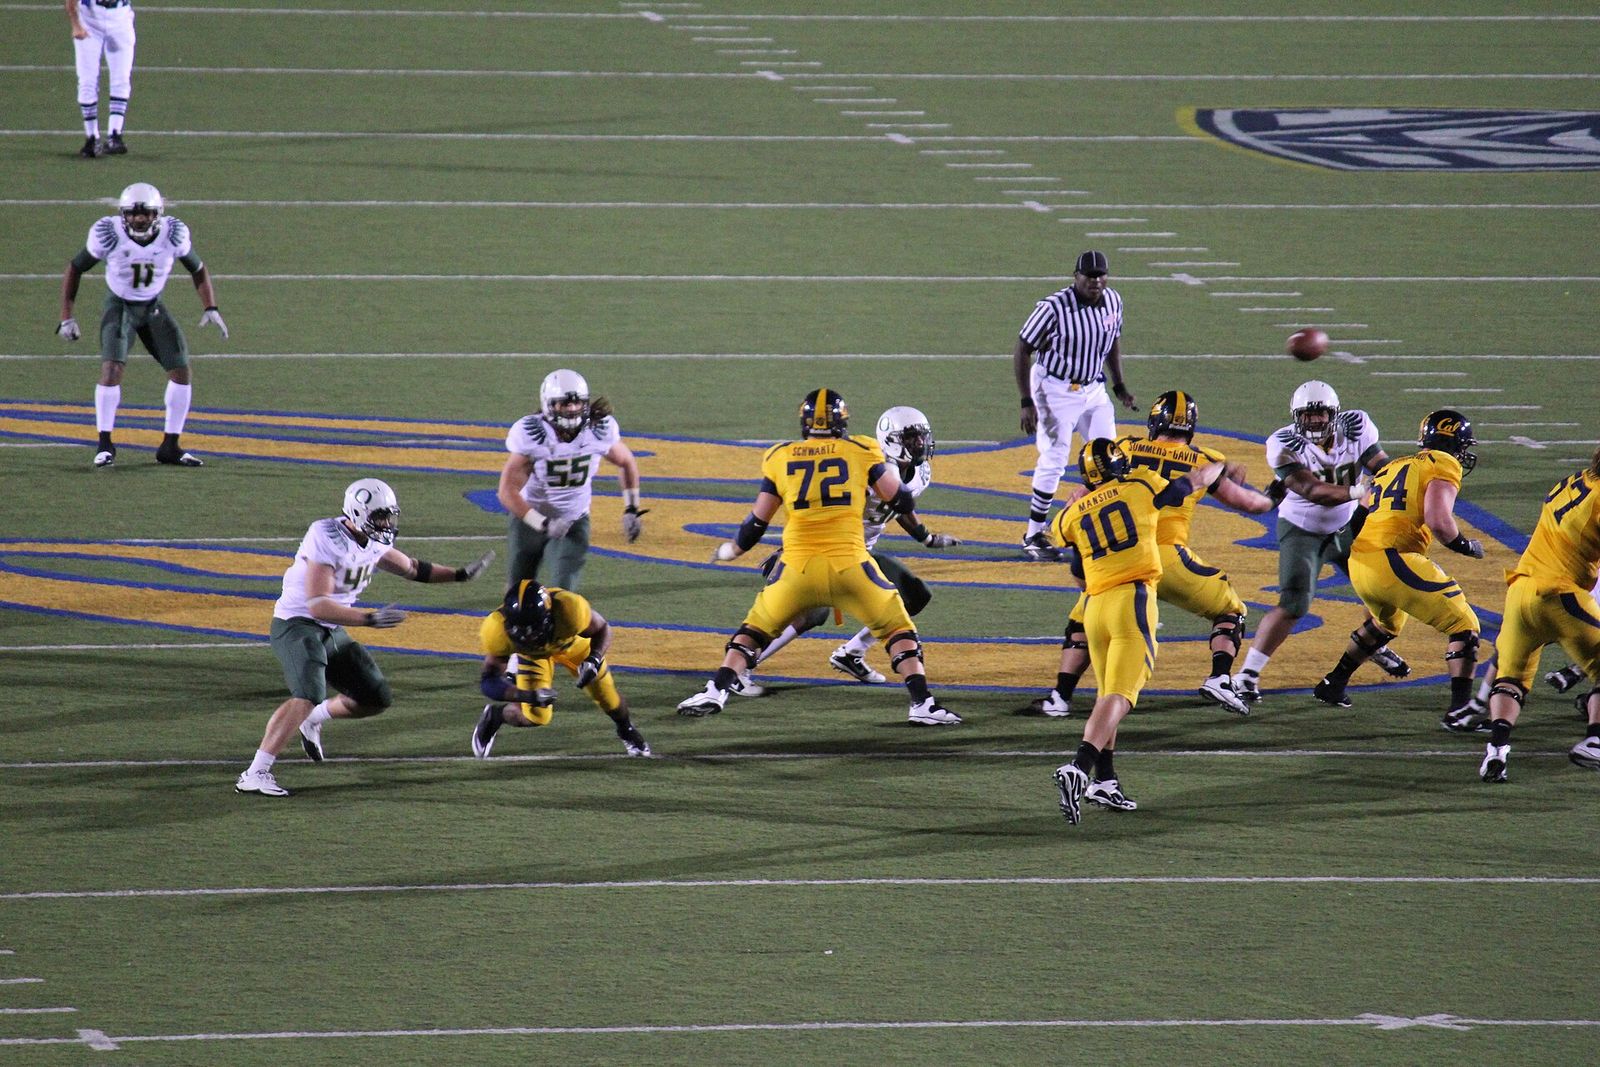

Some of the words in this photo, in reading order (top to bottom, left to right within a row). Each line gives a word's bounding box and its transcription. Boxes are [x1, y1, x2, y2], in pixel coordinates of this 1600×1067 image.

[130, 263, 155, 289] 11
[1436, 418, 1460, 437] Cal
[791, 443, 837, 457] SCHWARTZ
[546, 453, 592, 488] 55
[786, 457, 852, 510] 72
[1077, 487, 1120, 513] MANSION
[1080, 499, 1139, 560] 10
